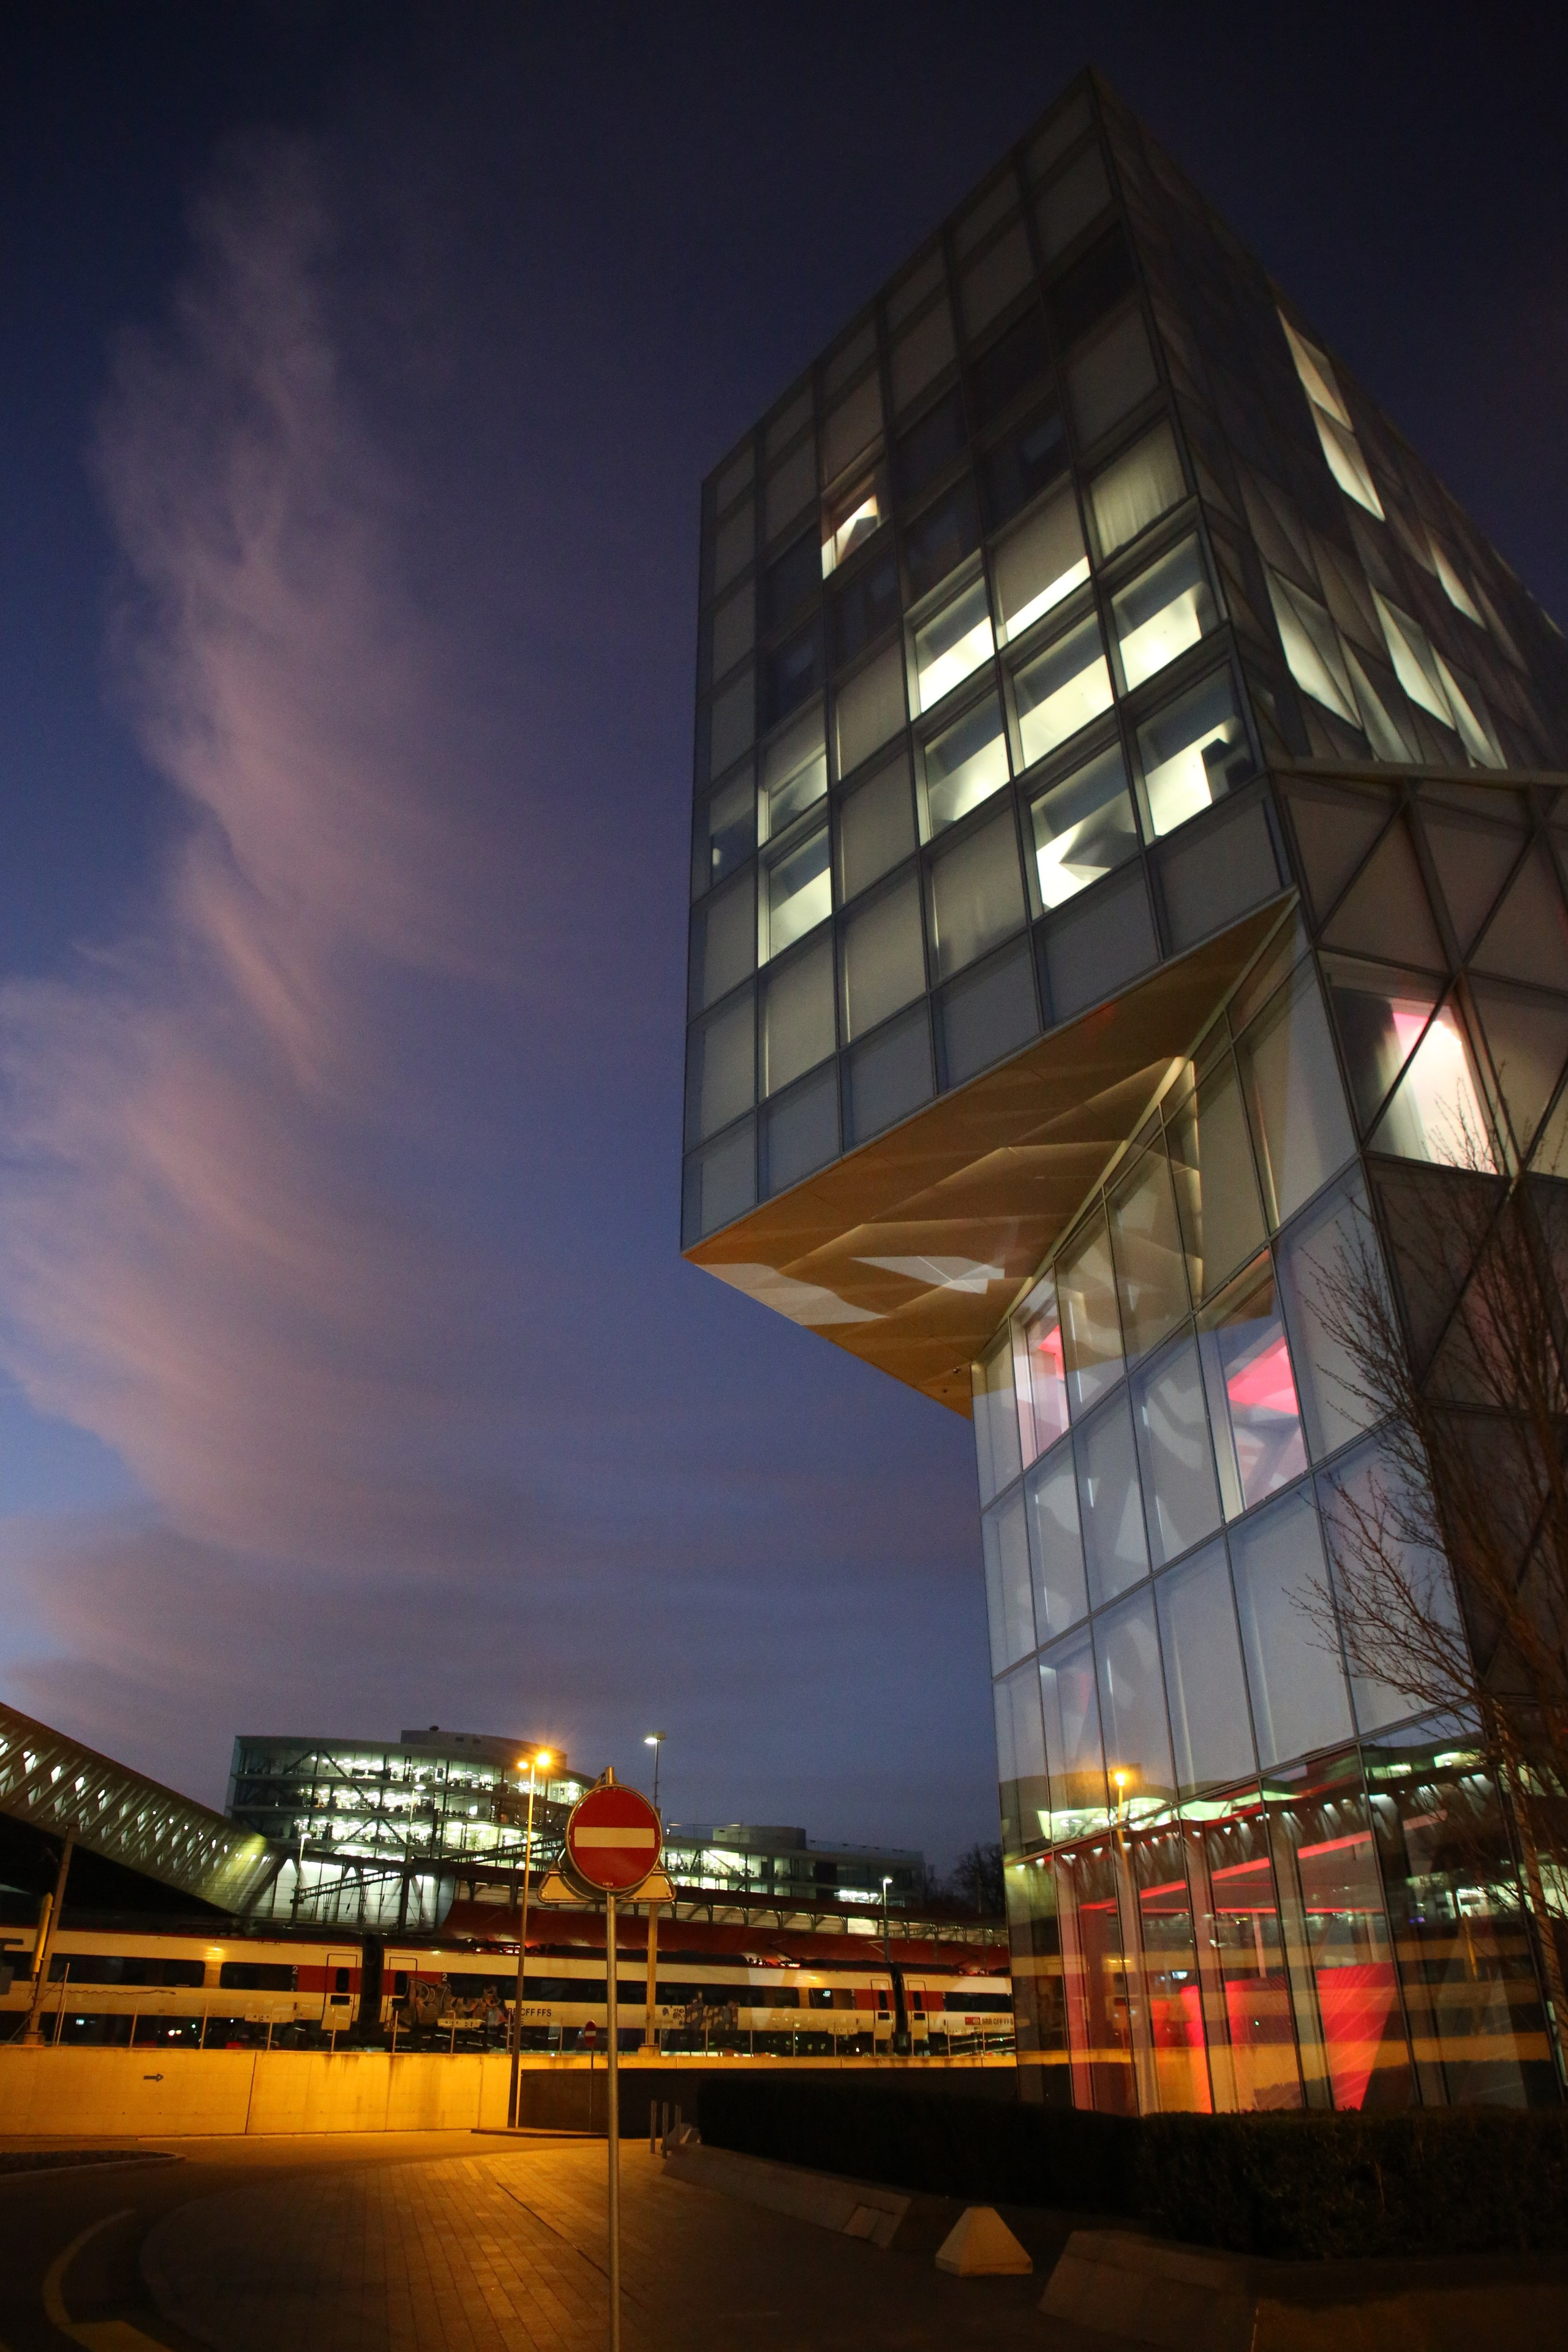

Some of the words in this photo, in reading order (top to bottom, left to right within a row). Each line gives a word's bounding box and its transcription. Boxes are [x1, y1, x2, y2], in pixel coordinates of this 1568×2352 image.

[292, 1966, 298, 1974] 2
[442, 1973, 447, 1981] 2
[521, 2008, 535, 2016] CFF
